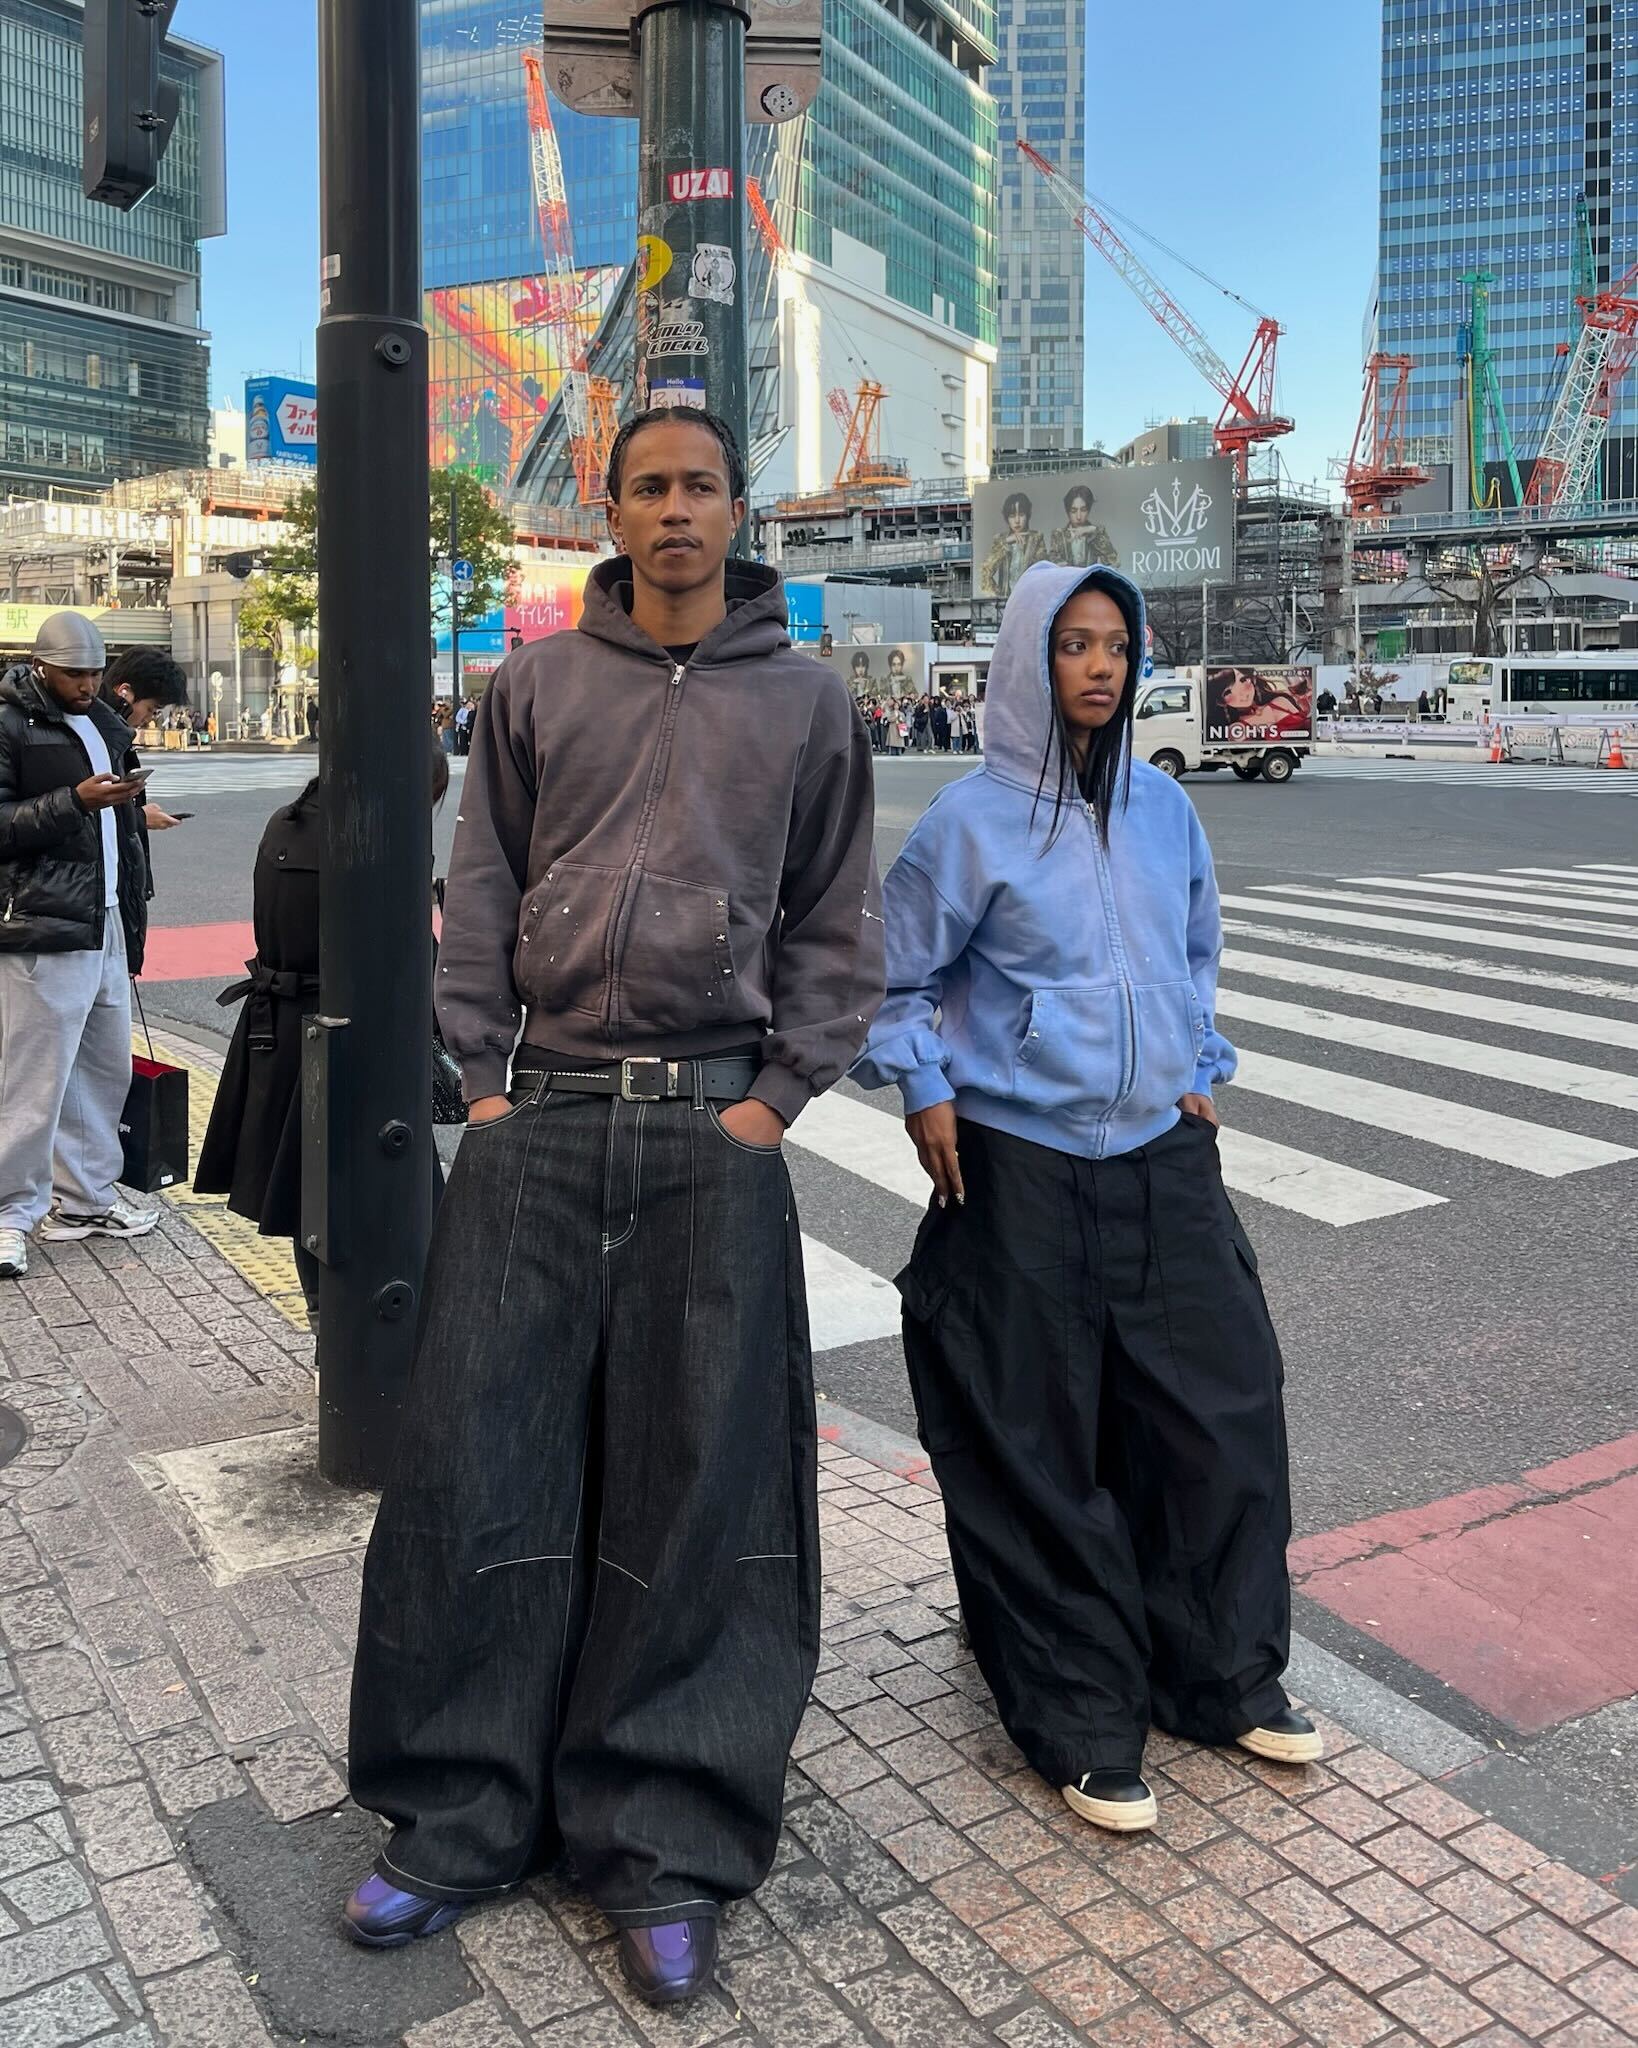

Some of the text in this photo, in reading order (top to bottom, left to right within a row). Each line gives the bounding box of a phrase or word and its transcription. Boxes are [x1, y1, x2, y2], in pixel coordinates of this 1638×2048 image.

[673, 170, 729, 199] UZAI
[649, 340, 706, 355] LOCAL
[1131, 546, 1221, 574] ROIROM
[7, 608, 29, 629] 駅
[1209, 724, 1279, 739] NIGHTS
